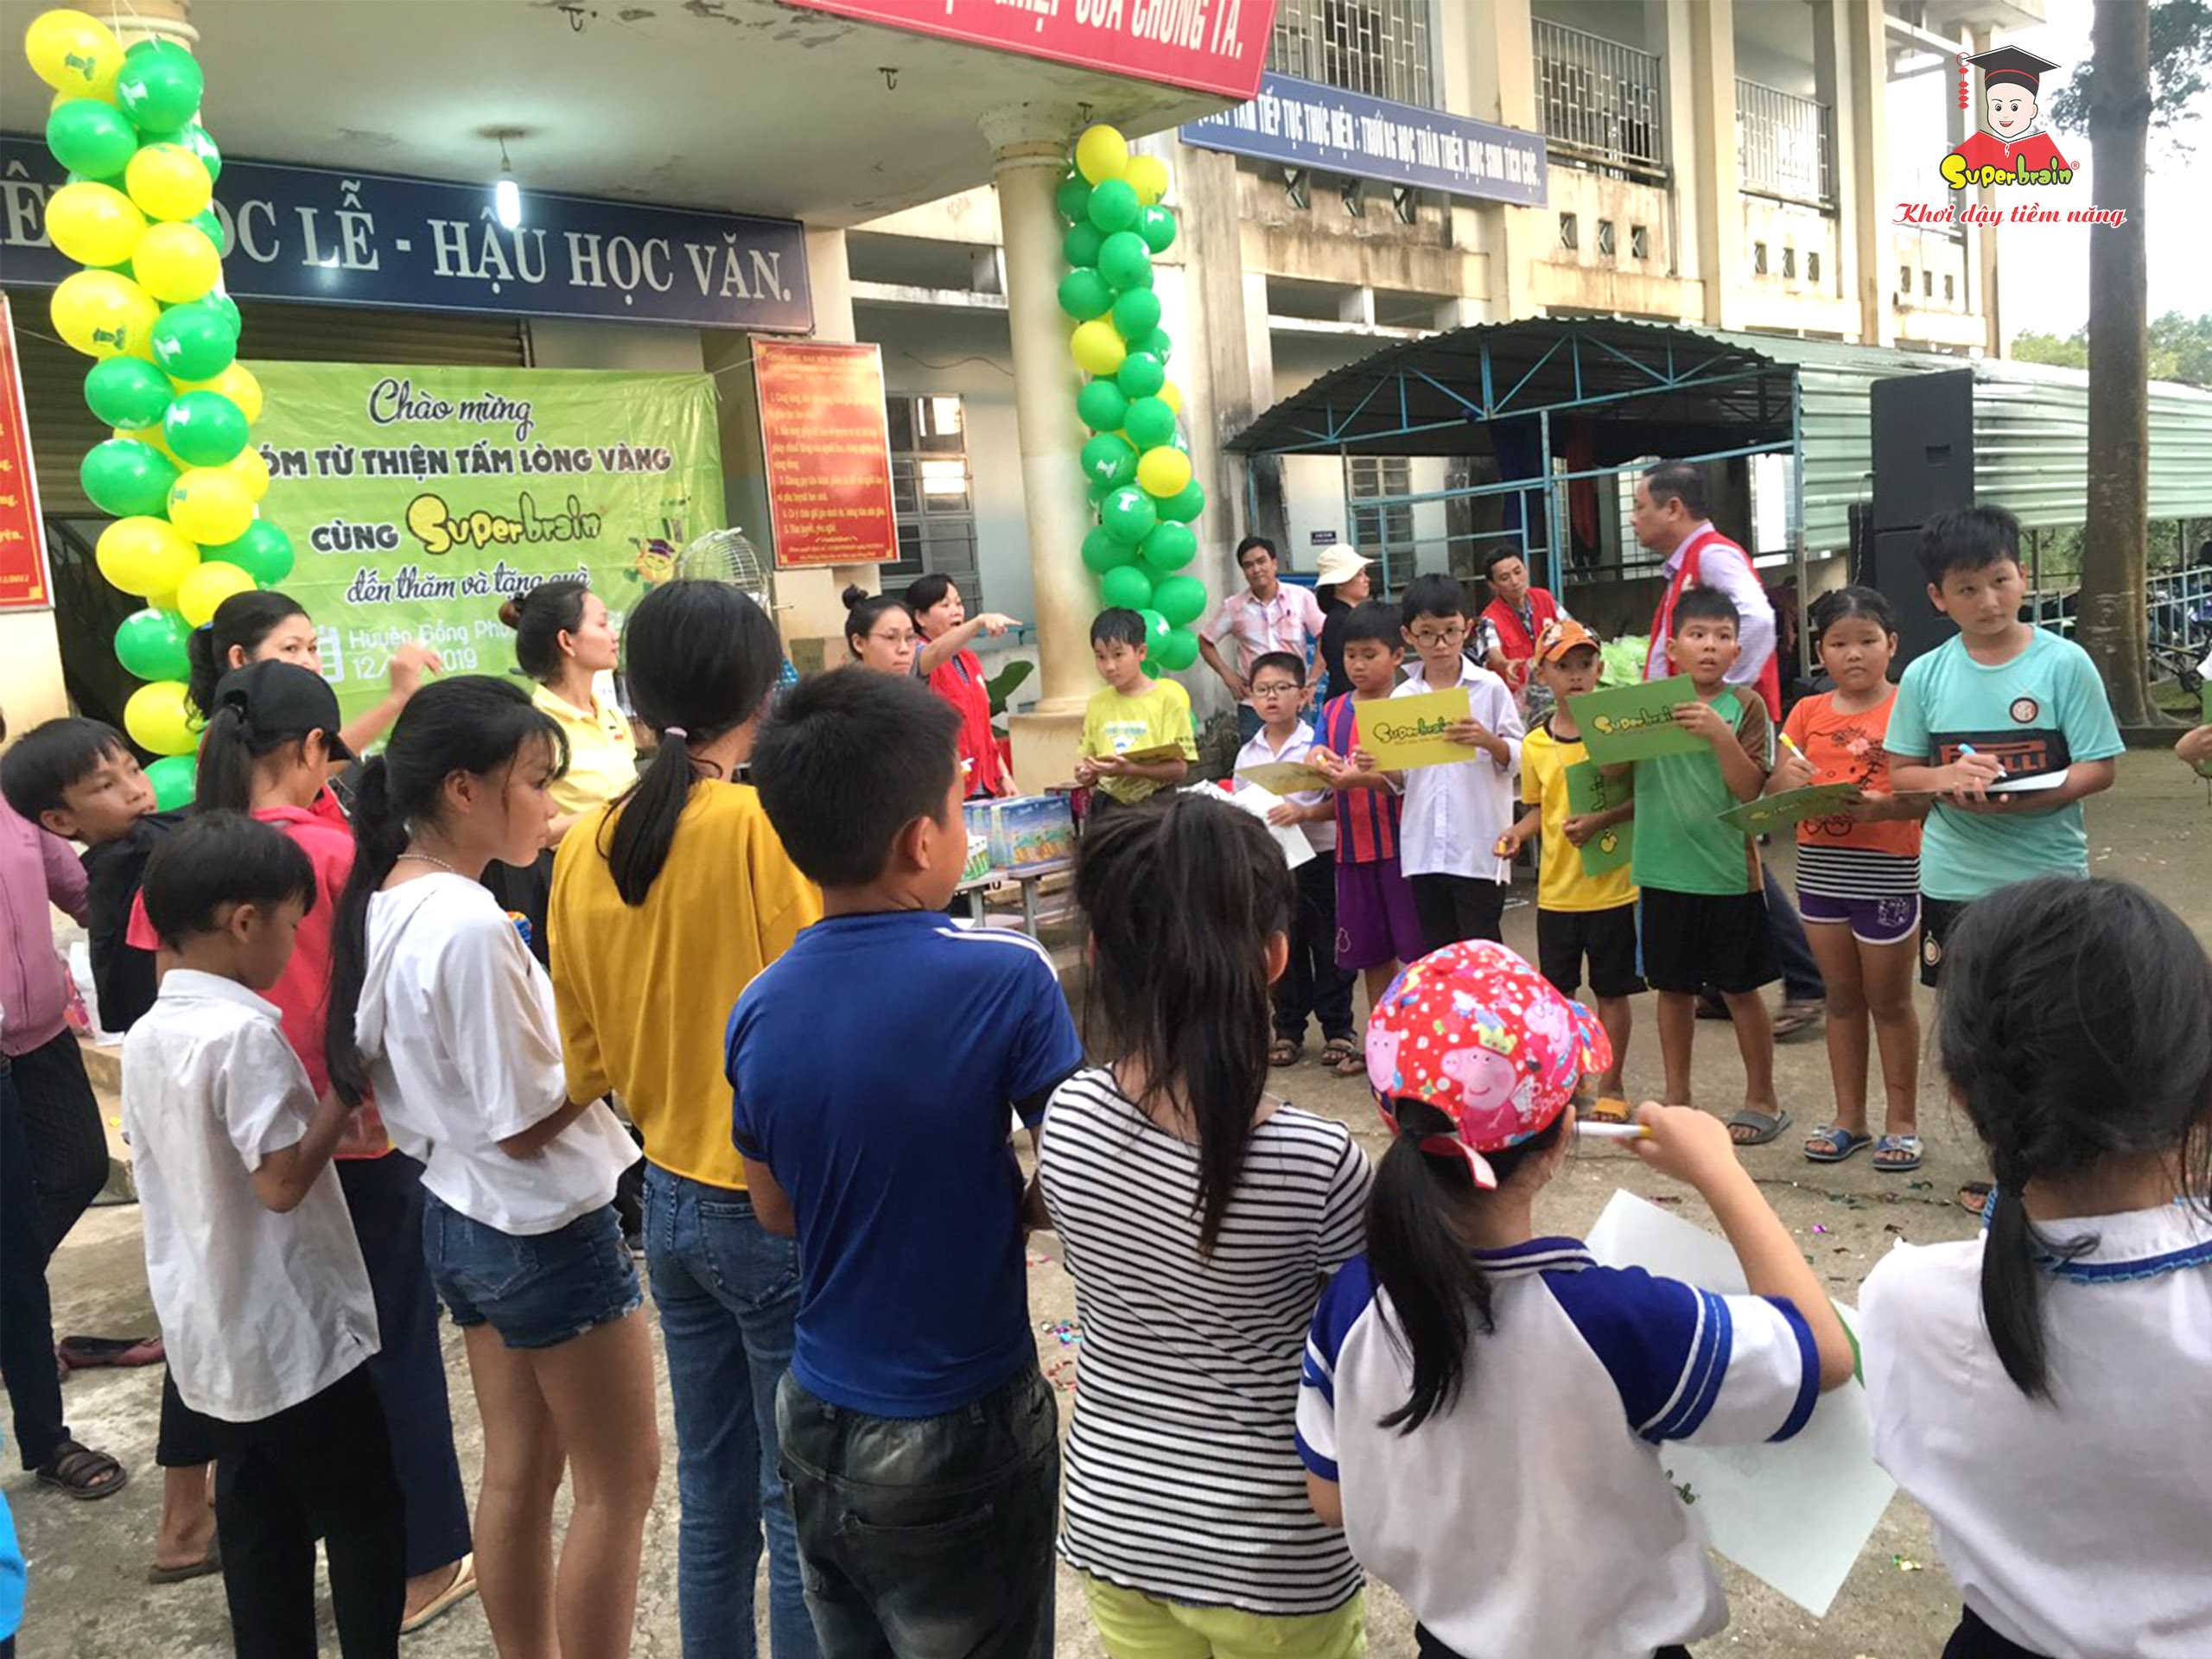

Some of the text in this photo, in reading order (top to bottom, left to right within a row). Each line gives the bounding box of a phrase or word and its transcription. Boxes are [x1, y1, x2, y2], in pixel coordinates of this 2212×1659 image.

[1257, 86, 1280, 136] TIẾP
[1282, 99, 1303, 149] TỤC
[1304, 100, 1330, 156] THỰC
[1361, 109, 1396, 161] TRƯỜNG
[1397, 124, 1415, 172] HỌC
[1416, 124, 1440, 168] THÂN
[1485, 143, 1504, 180] SINH
[296, 180, 378, 270] LỄ
[427, 207, 546, 294] HẬU
[563, 232, 673, 305] HỌC
[684, 231, 792, 302] VĂN.
[369, 378, 534, 442] Chào mừng
[260, 439, 671, 481] ÓM TỪ THIỆN TẤM LÒNG VÀNG
[310, 491, 602, 555] CÙNG Superbrain
[346, 568, 391, 603] đến
[395, 565, 454, 600] thăm
[461, 570, 491, 597] và
[1939, 740, 2047, 772] PLLI
